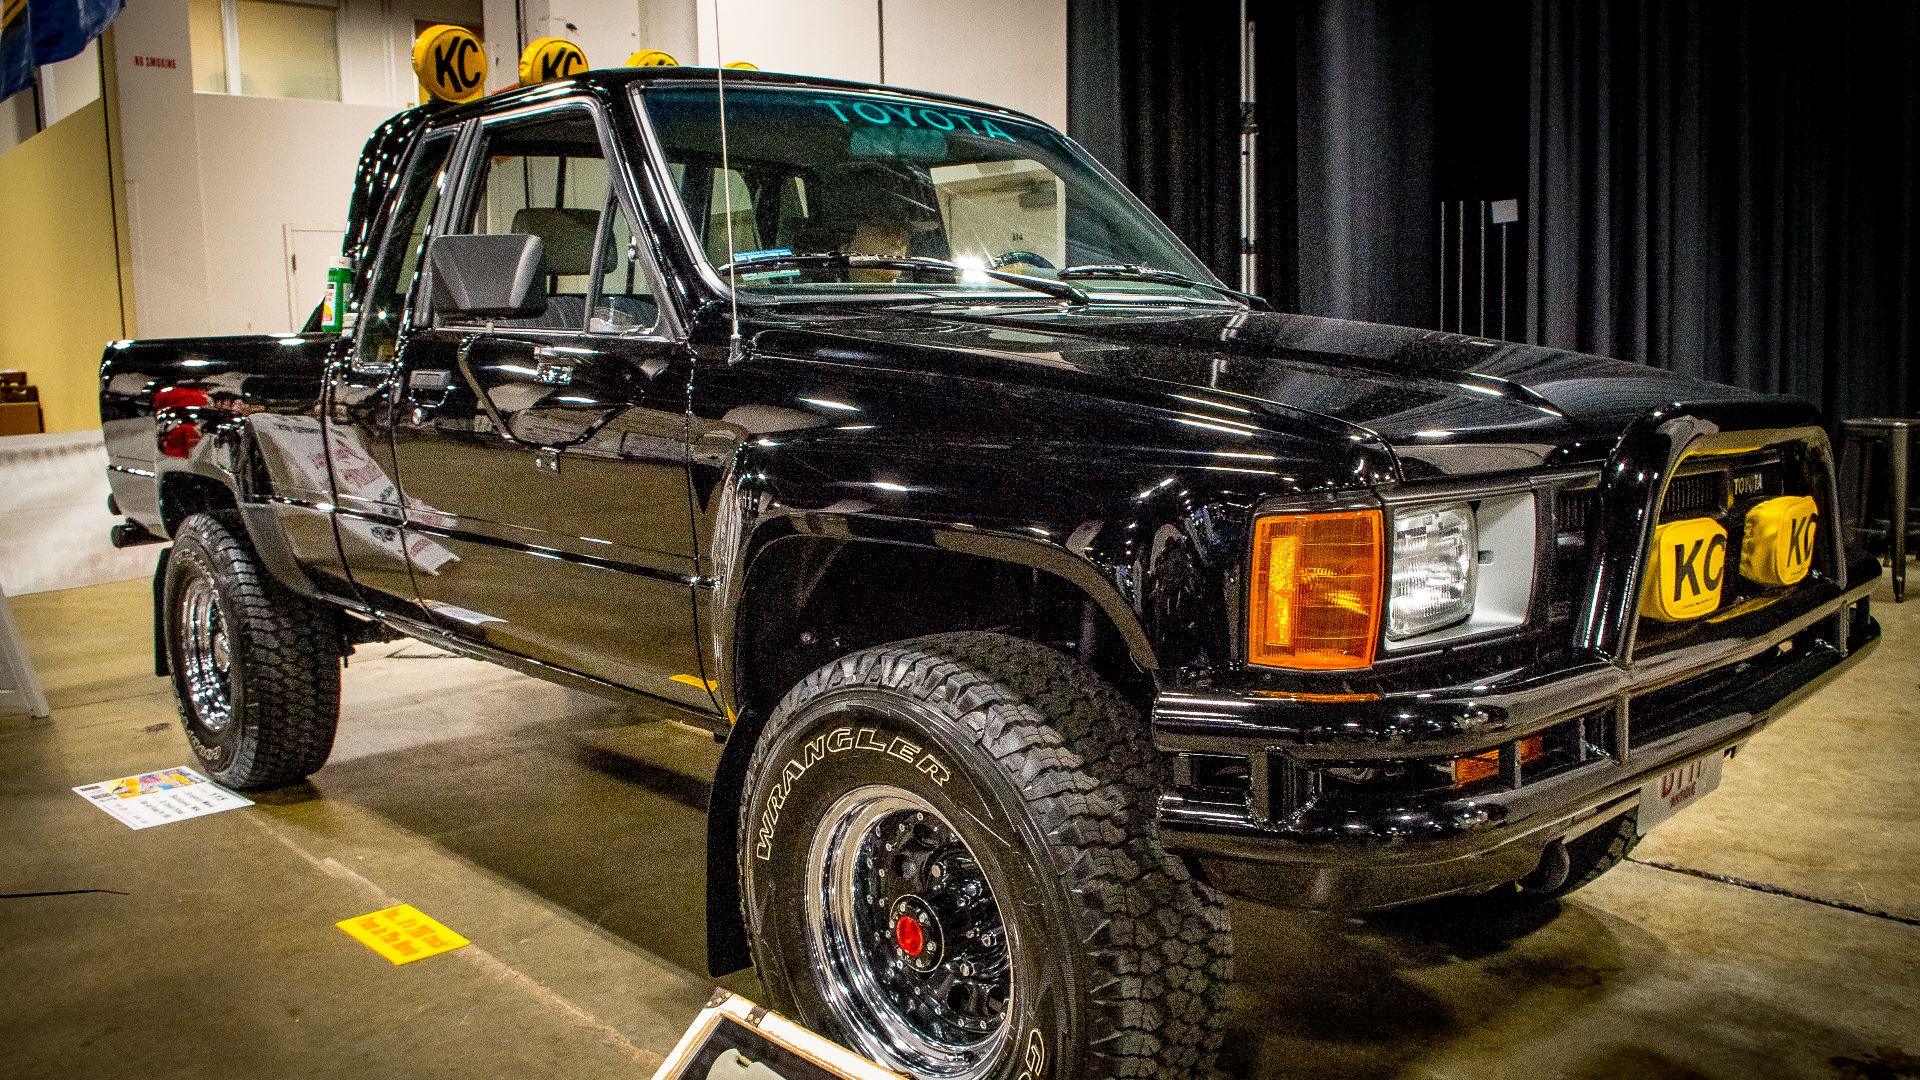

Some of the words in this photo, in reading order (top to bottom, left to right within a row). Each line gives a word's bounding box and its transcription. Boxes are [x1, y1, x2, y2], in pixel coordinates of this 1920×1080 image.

[435, 36, 481, 93] KC
[815, 99, 1017, 143] TOYOTA
[1673, 533, 1727, 603] KC
[1787, 512, 1818, 568] KC
[756, 728, 951, 861] WRANGLER
